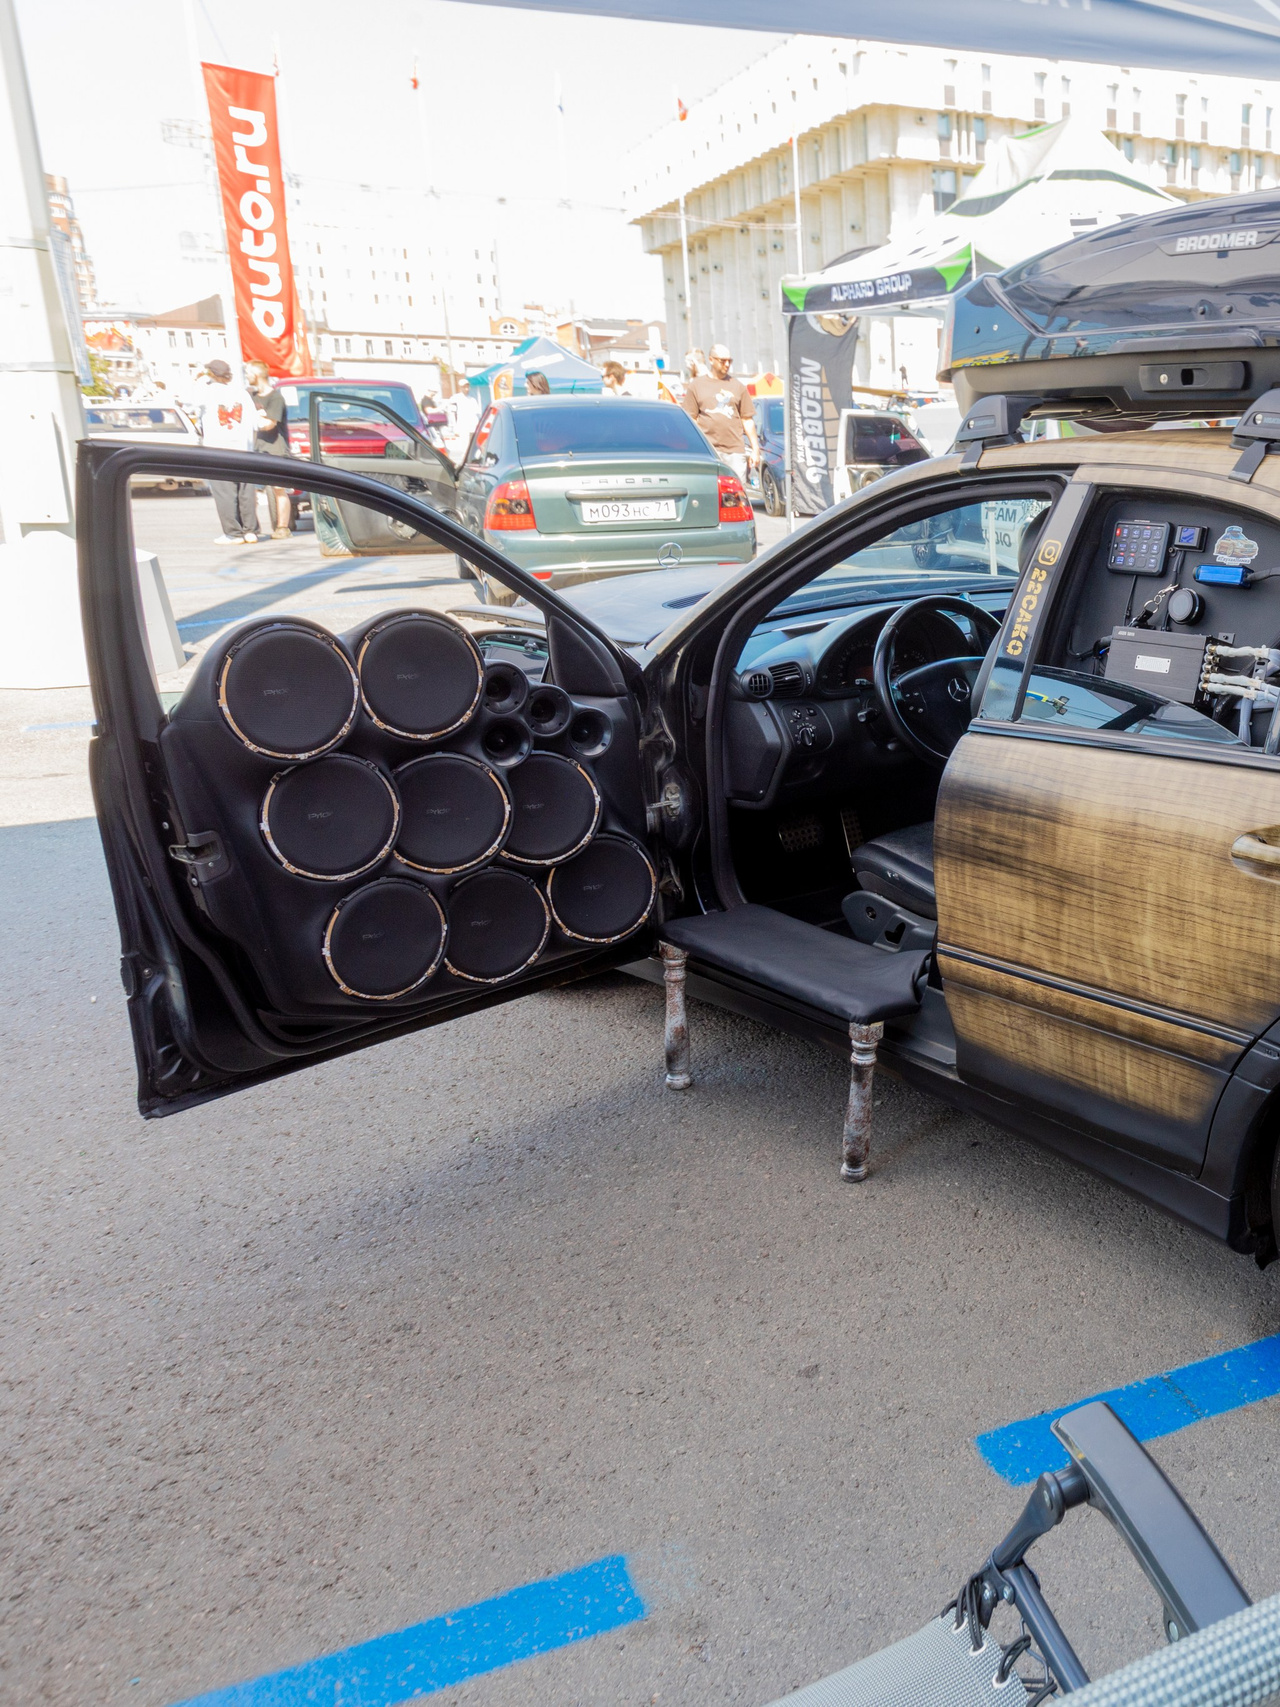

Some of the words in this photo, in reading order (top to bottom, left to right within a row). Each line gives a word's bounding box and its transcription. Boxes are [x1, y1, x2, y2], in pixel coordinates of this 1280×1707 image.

[228, 105, 286, 339] auto.ru
[1175, 230, 1258, 252] BROOMER
[831, 281, 875, 302] ALPHARD
[875, 274, 912, 296] GROUP
[801, 357, 828, 484] МЕДВЕДЬ
[655, 502, 670, 512] 71
